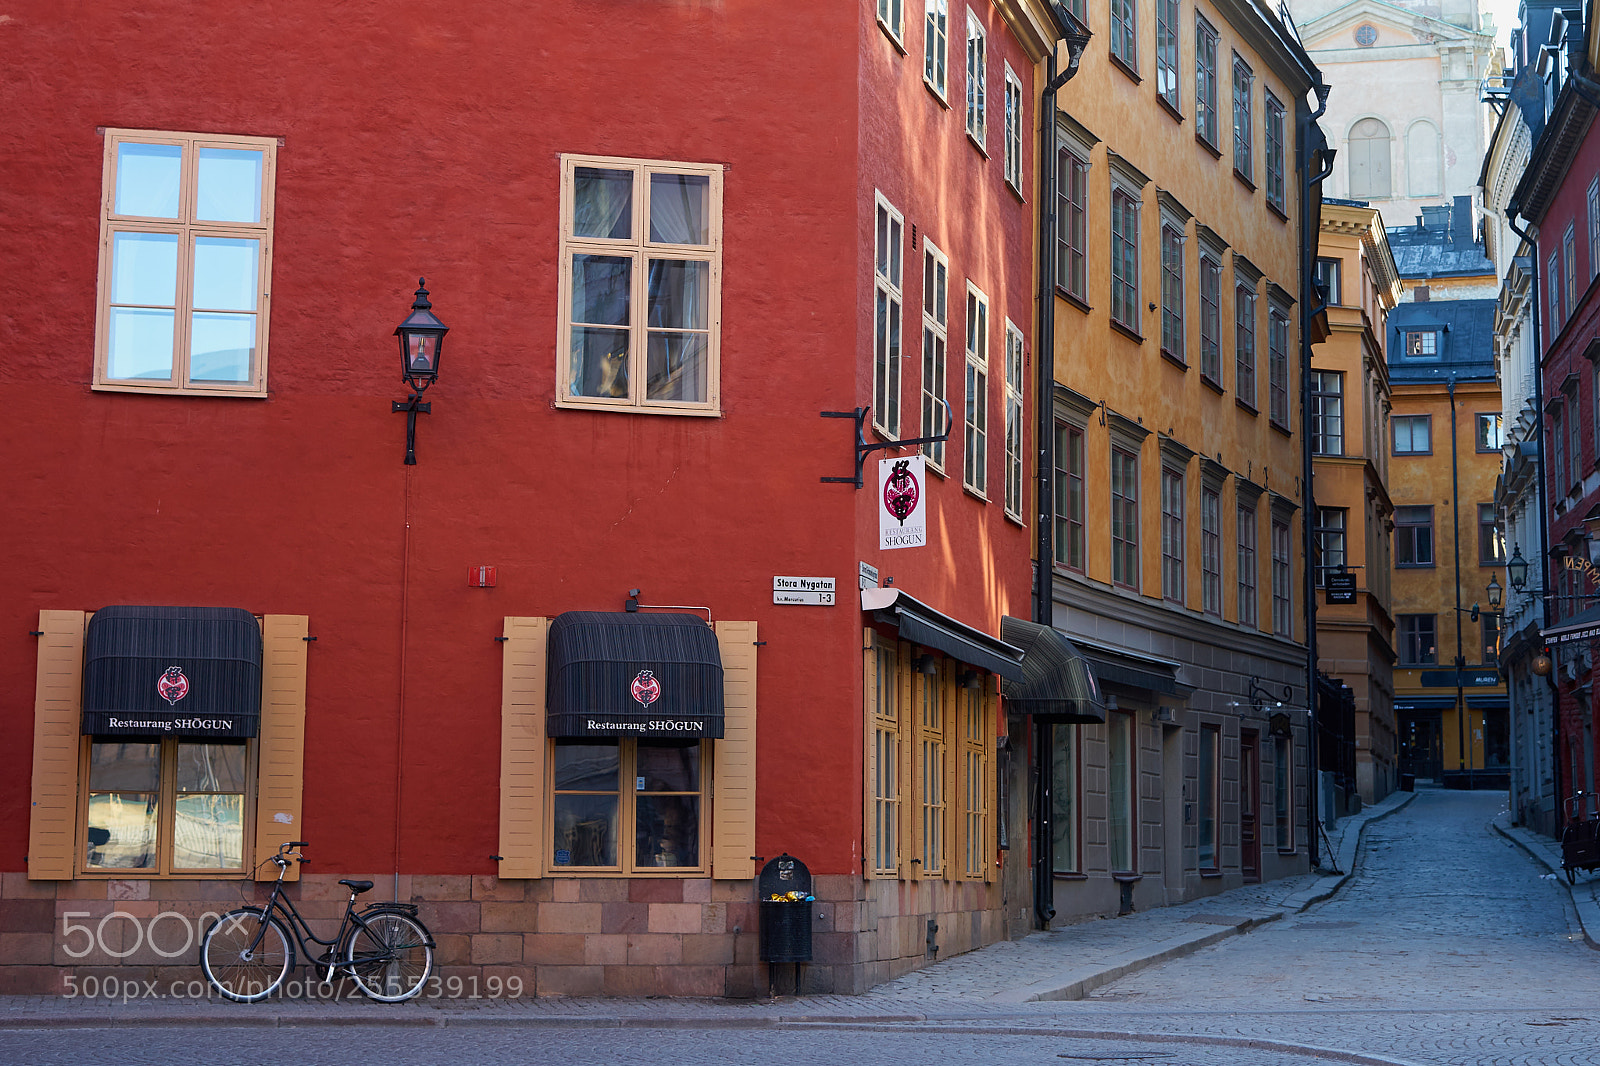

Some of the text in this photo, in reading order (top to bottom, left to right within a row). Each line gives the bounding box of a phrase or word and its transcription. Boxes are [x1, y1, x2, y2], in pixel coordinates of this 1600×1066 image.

[885, 534, 922, 546] SHOGUN
[777, 578, 833, 590] Stora Nygatan
[819, 594, 832, 603] 1-3
[109, 717, 172, 731] Restaurang
[587, 720, 646, 732] Restaurang
